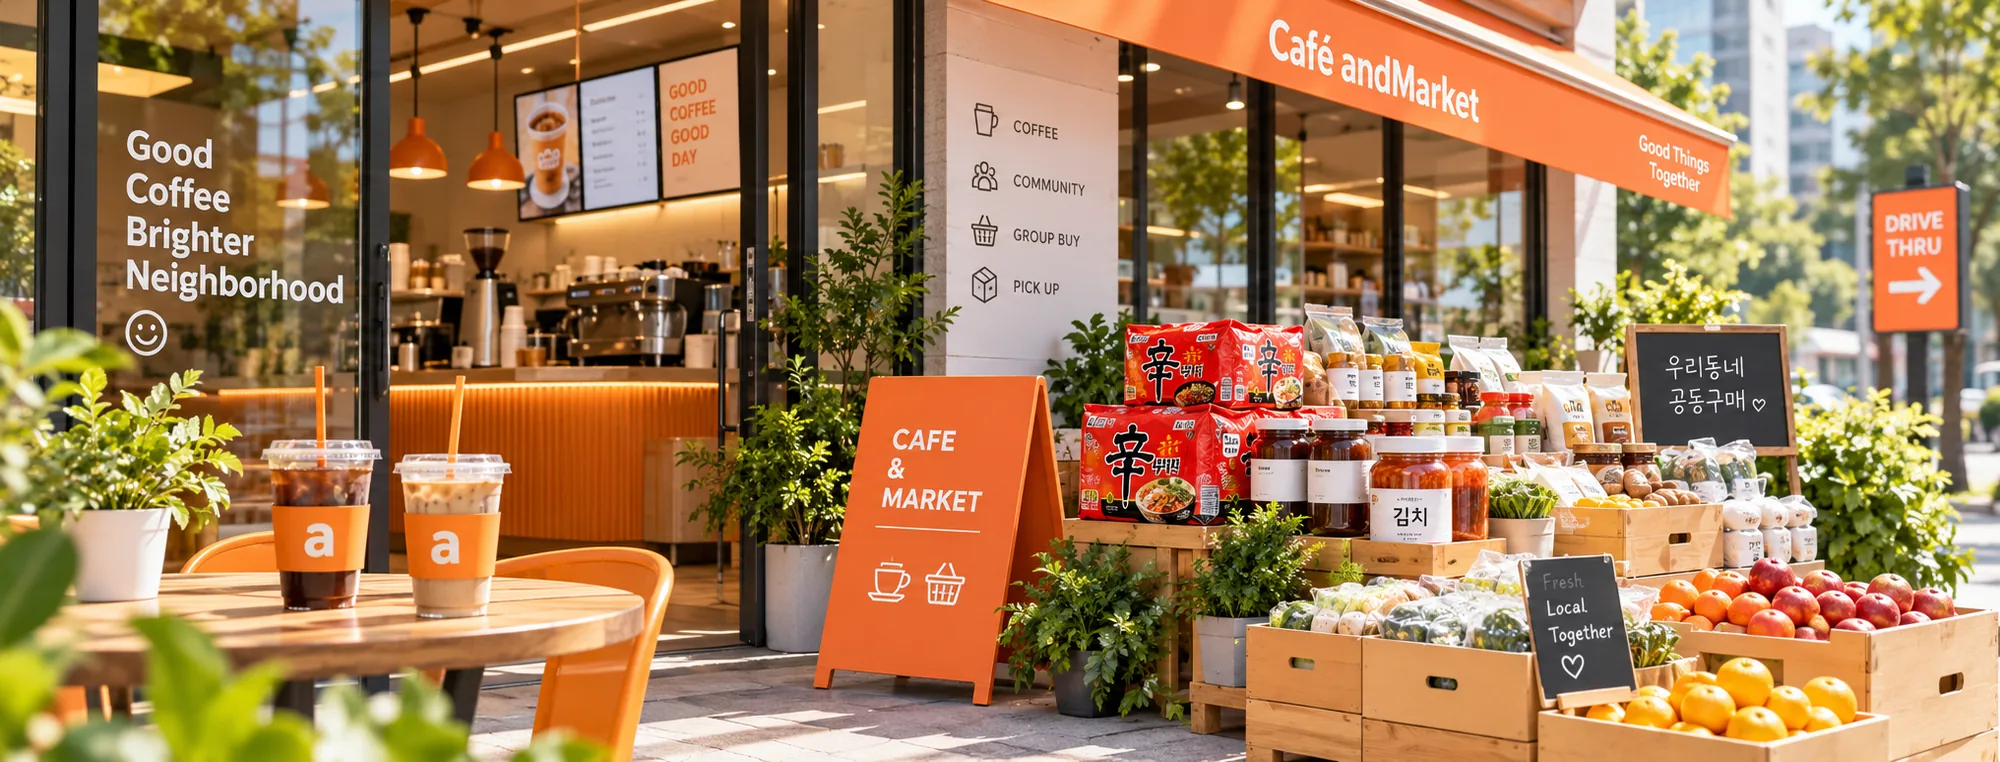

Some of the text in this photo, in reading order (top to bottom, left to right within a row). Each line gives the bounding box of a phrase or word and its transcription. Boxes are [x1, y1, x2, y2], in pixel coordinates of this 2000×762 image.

[1269, 19, 1479, 123] Café andMarket
[669, 79, 706, 100] GOOD
[670, 99, 716, 121] COFFEE
[671, 125, 709, 145] GOOD
[1014, 120, 1058, 140] COFFEE
[127, 130, 212, 169] Good
[672, 149, 696, 167] DAY
[1639, 134, 1710, 174] Good Things
[1014, 174, 1085, 196] COMMUNITY
[1650, 160, 1700, 193] Together
[127, 172, 231, 213] Coffee
[1885, 211, 1944, 232] DRIVE
[127, 216, 254, 259] Brighter
[1014, 228, 1080, 247] GROUP BUY
[1886, 237, 1942, 257] THRU
[127, 259, 344, 304] Neighborhood
[1014, 280, 1059, 295] PICK UP
[1666, 355, 1743, 380] 우리동네
[1669, 389, 1744, 414] 공동구매
[892, 428, 956, 452] CAFE
[888, 457, 905, 479] &
[882, 488, 982, 512] MARKET
[1394, 507, 1426, 526] 김치
[305, 524, 333, 557] a
[432, 531, 459, 564] a
[1543, 572, 1584, 590] Fresh
[1548, 624, 1613, 647] Together
